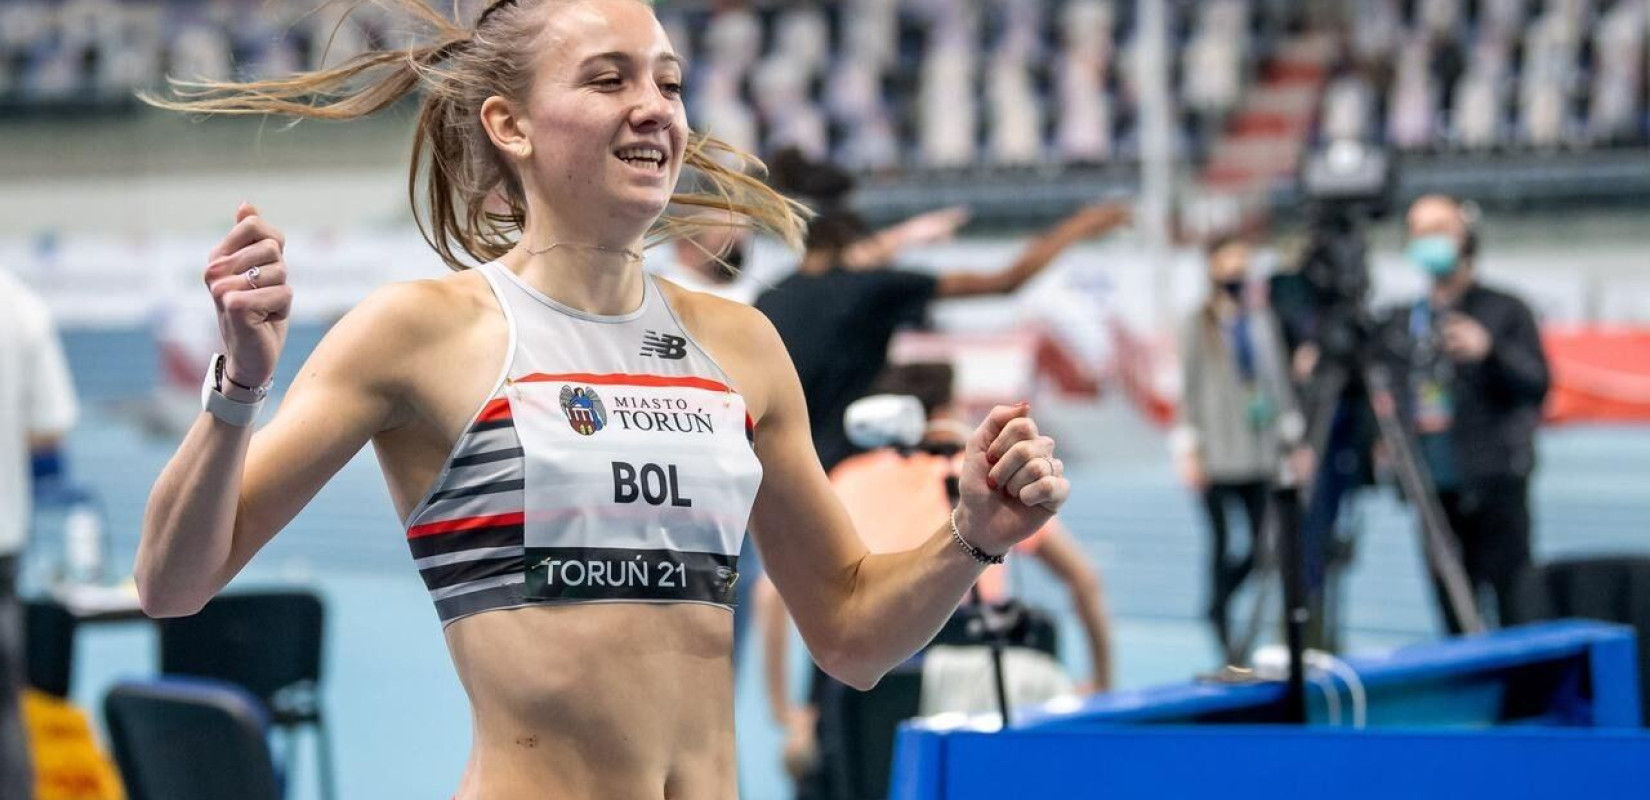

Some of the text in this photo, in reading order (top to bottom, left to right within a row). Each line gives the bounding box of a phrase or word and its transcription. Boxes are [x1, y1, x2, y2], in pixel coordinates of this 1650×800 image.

[615, 397, 688, 410] MIASTO
[613, 408, 714, 433] TORUŃ
[611, 461, 692, 508] BOL
[544, 554, 687, 588] TORUŃ 21
